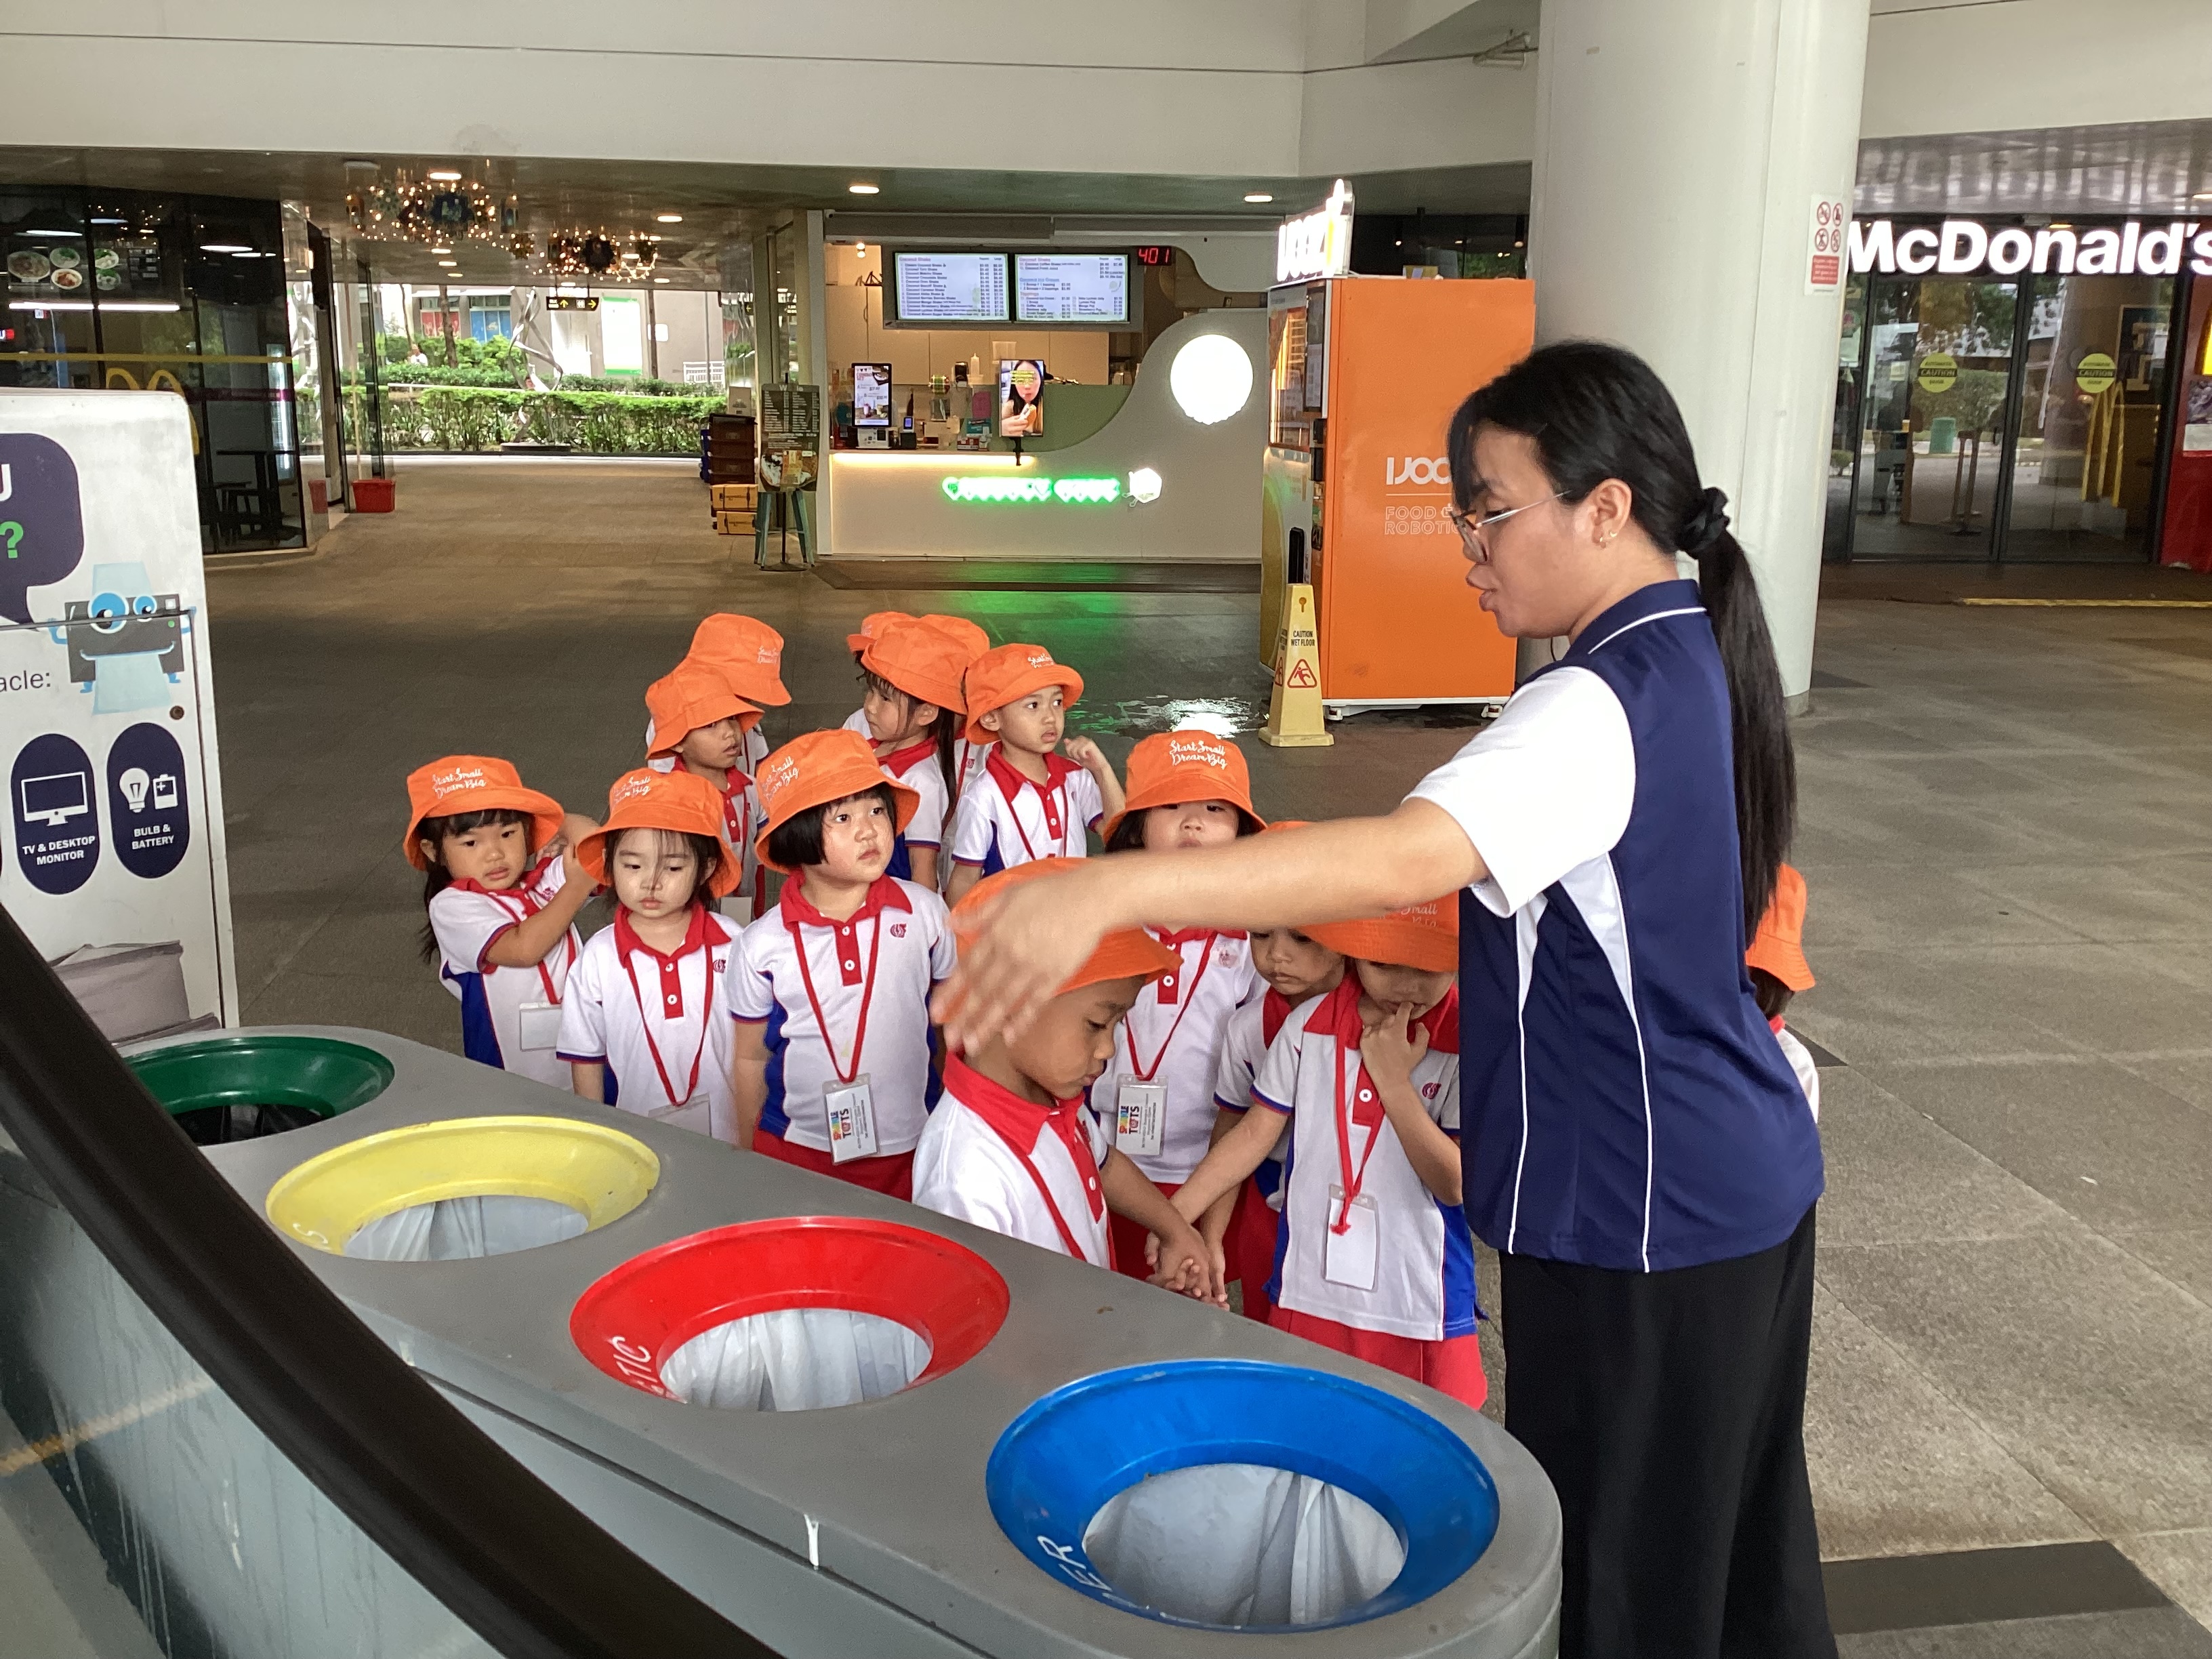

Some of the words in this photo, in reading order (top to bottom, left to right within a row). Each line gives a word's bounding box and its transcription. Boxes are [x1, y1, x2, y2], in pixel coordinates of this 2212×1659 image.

[1139, 247, 1170, 263] 401
[1921, 369, 1955, 377] CAUTION
[1385, 506, 1437, 520] FOOD
[1290, 638, 1300, 647] WET
[1300, 638, 1315, 647] FLOOR
[1169, 739, 1197, 754] Start
[1197, 740, 1226, 756] Small
[1171, 753, 1207, 767] Dream
[1207, 753, 1228, 770] Big
[453, 767, 484, 782] Small
[134, 824, 161, 838] BULB
[163, 822, 171, 833] &
[22, 844, 36, 855] TV
[37, 842, 47, 853] &
[48, 835, 96, 851] DESKTOP
[131, 835, 175, 850] BATTERY
[36, 849, 85, 865] MONITOR
